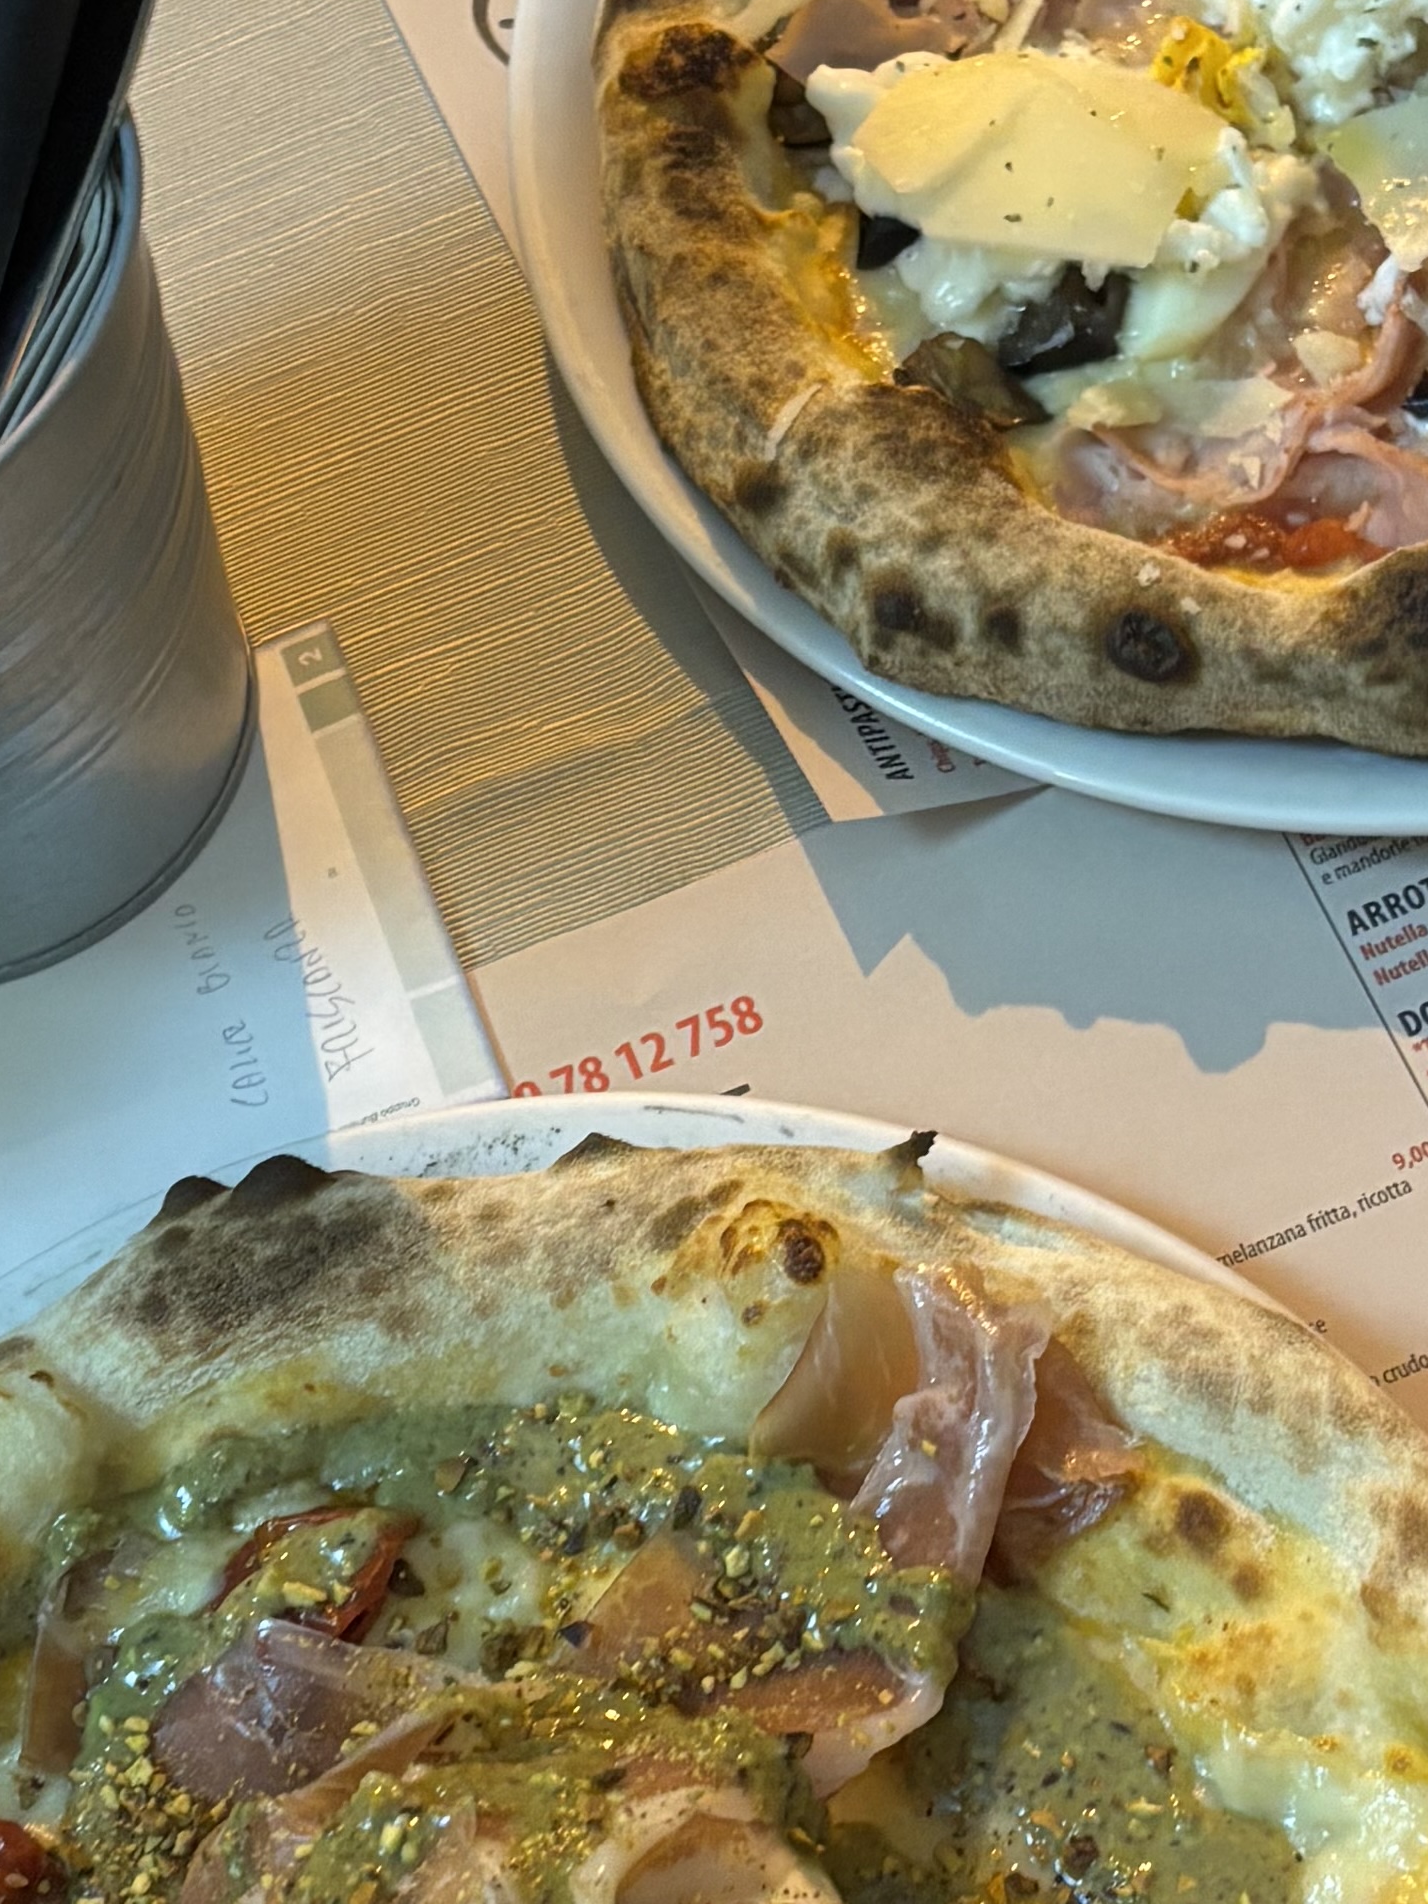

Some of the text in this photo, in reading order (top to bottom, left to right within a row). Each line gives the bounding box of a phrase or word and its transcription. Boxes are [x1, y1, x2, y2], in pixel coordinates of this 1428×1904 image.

[614, 1031, 676, 1080] 12
[674, 995, 764, 1058] 758
[1305, 1204, 1358, 1233] fritta,
[1356, 1179, 1414, 1213] ricotta
